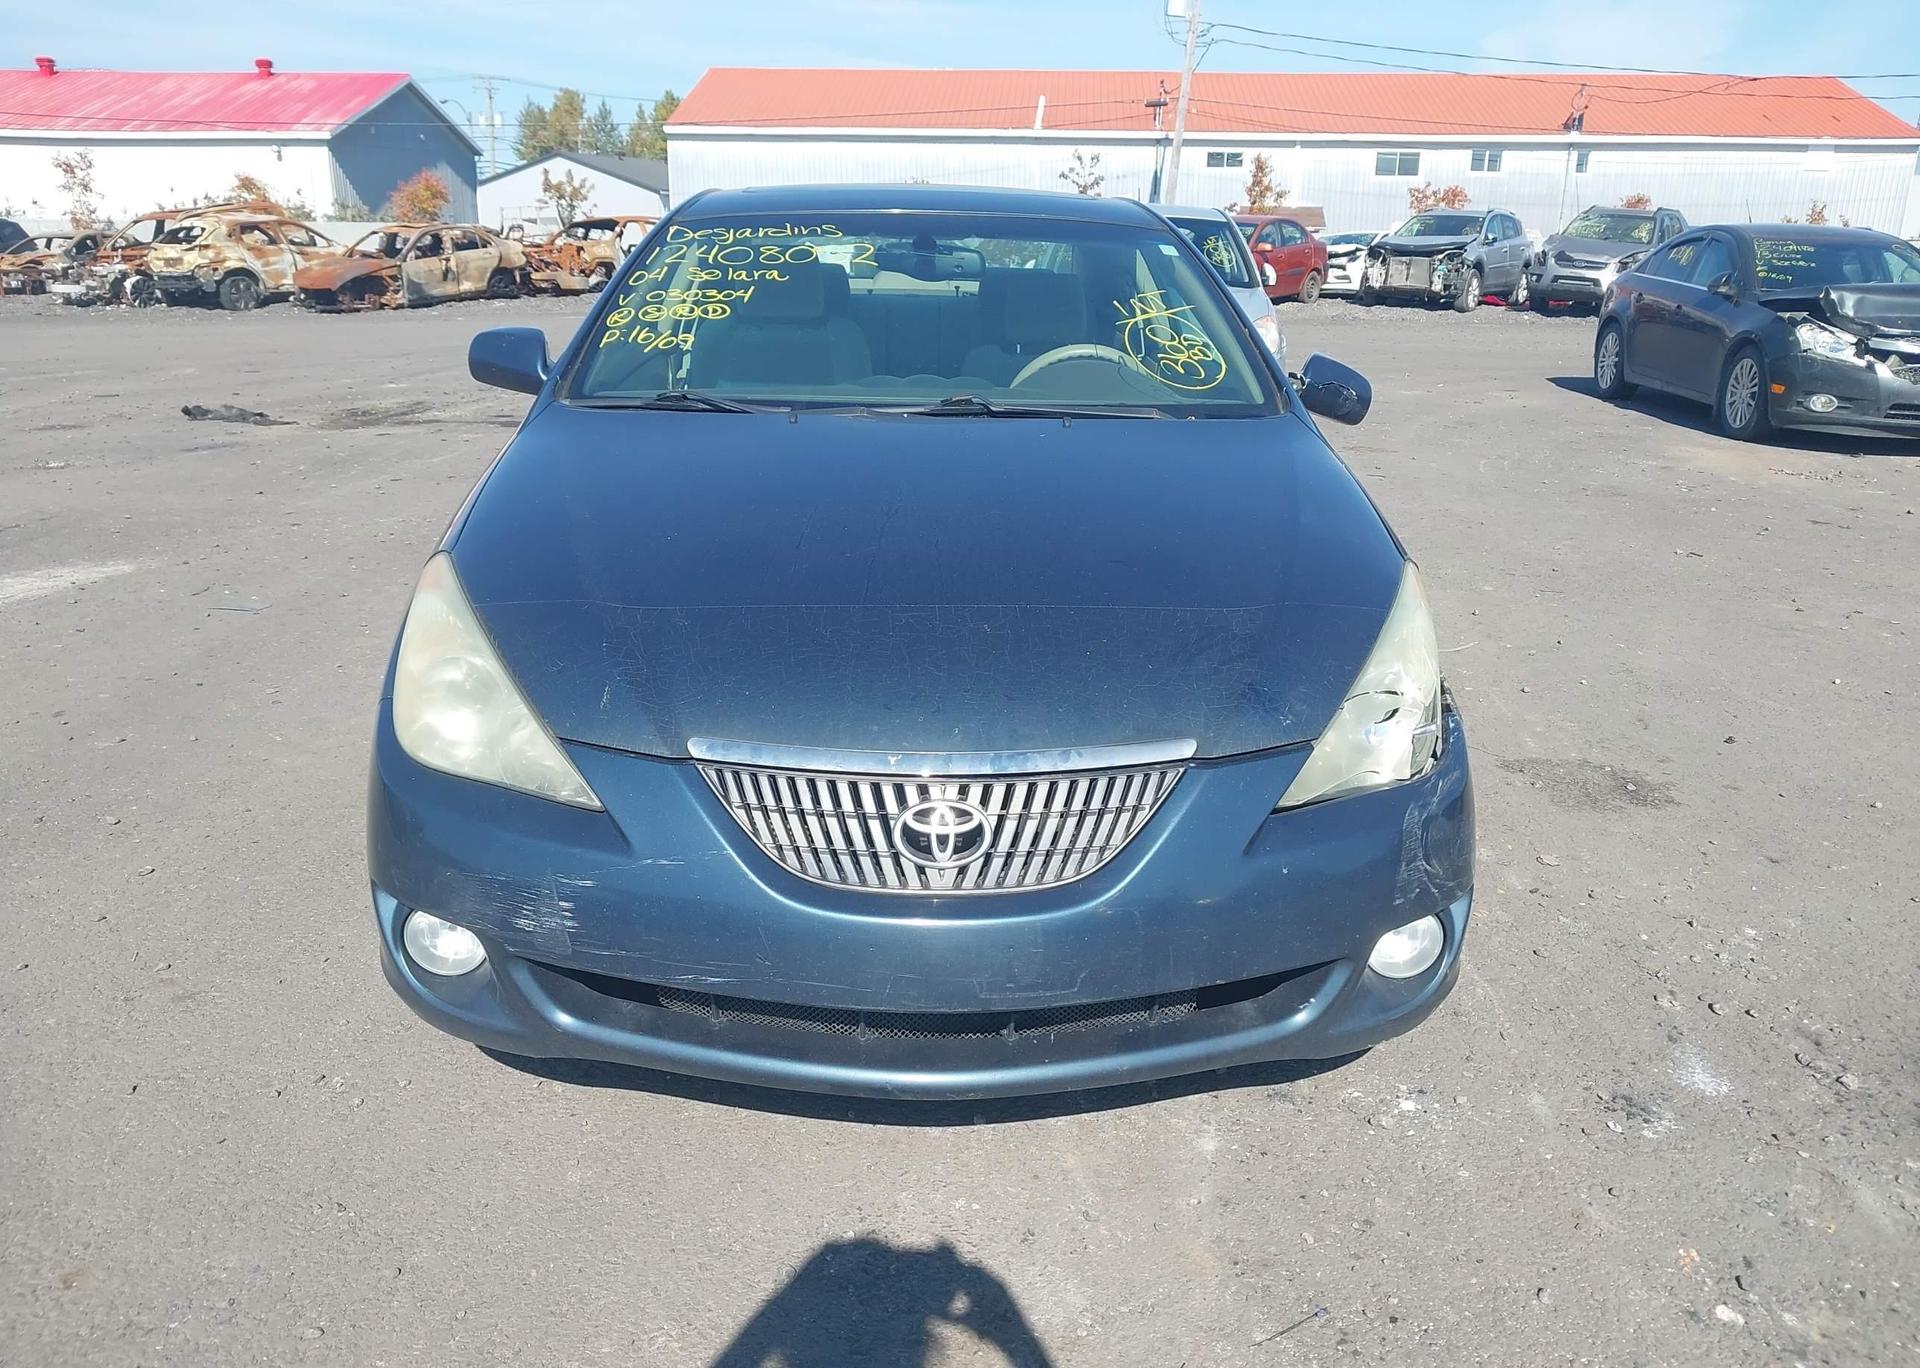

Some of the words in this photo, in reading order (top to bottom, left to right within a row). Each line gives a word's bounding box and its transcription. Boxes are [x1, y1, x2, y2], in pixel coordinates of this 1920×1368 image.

[666, 223, 843, 245] Desjardins
[628, 266, 668, 286] 04
[687, 266, 790, 282] Solara
[646, 286, 755, 303] 030304
